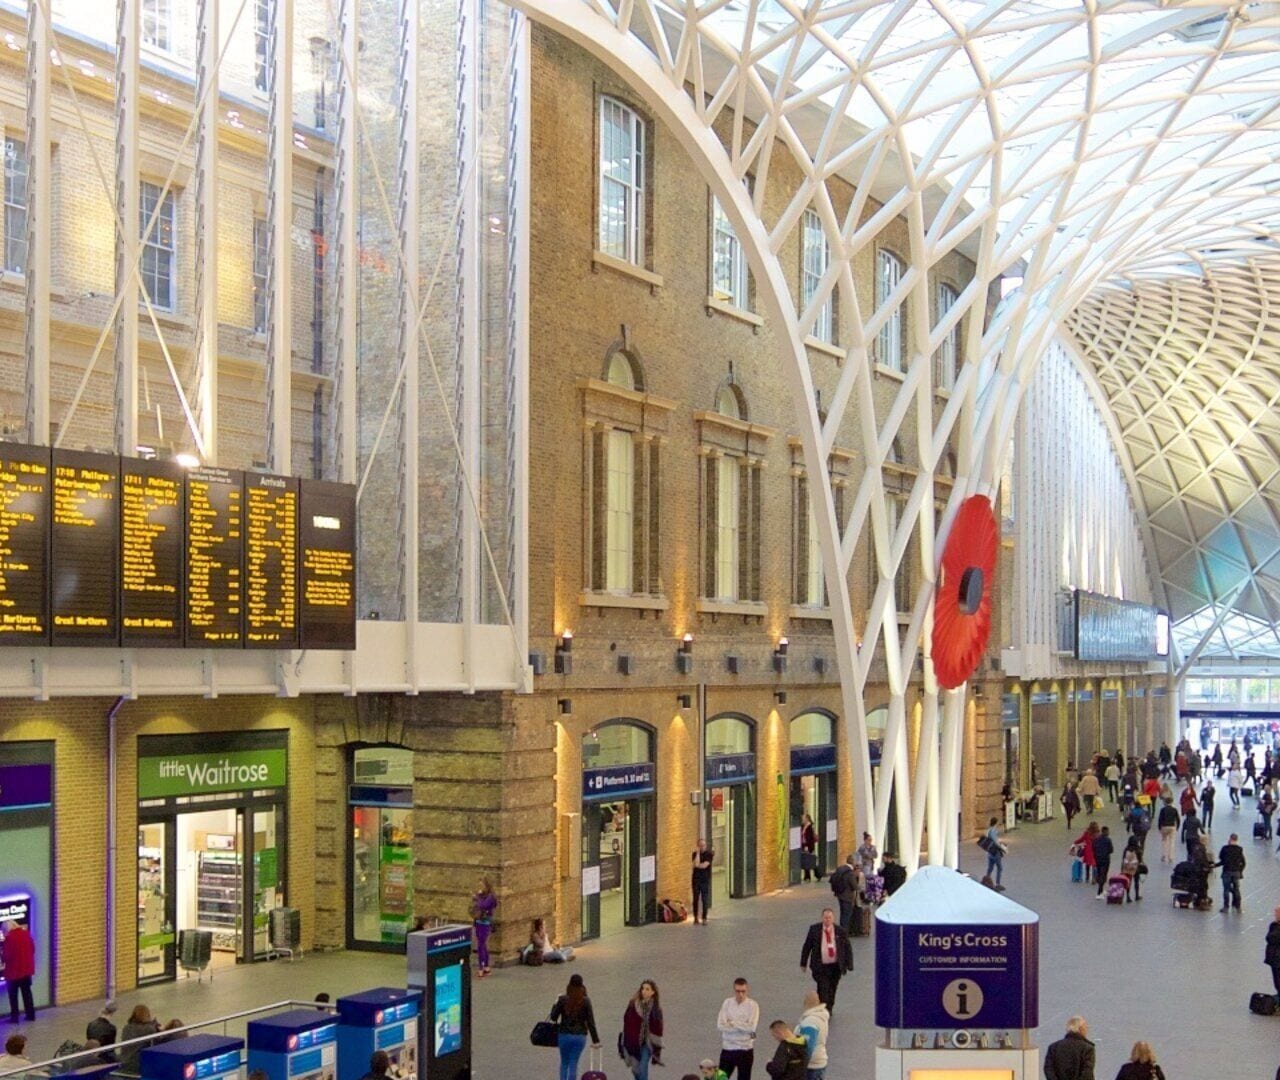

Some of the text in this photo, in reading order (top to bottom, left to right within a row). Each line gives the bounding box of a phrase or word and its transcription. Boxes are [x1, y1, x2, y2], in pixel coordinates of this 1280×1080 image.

[160, 759, 268, 787] little Waitrose
[919, 933, 1007, 950] King's Cross
